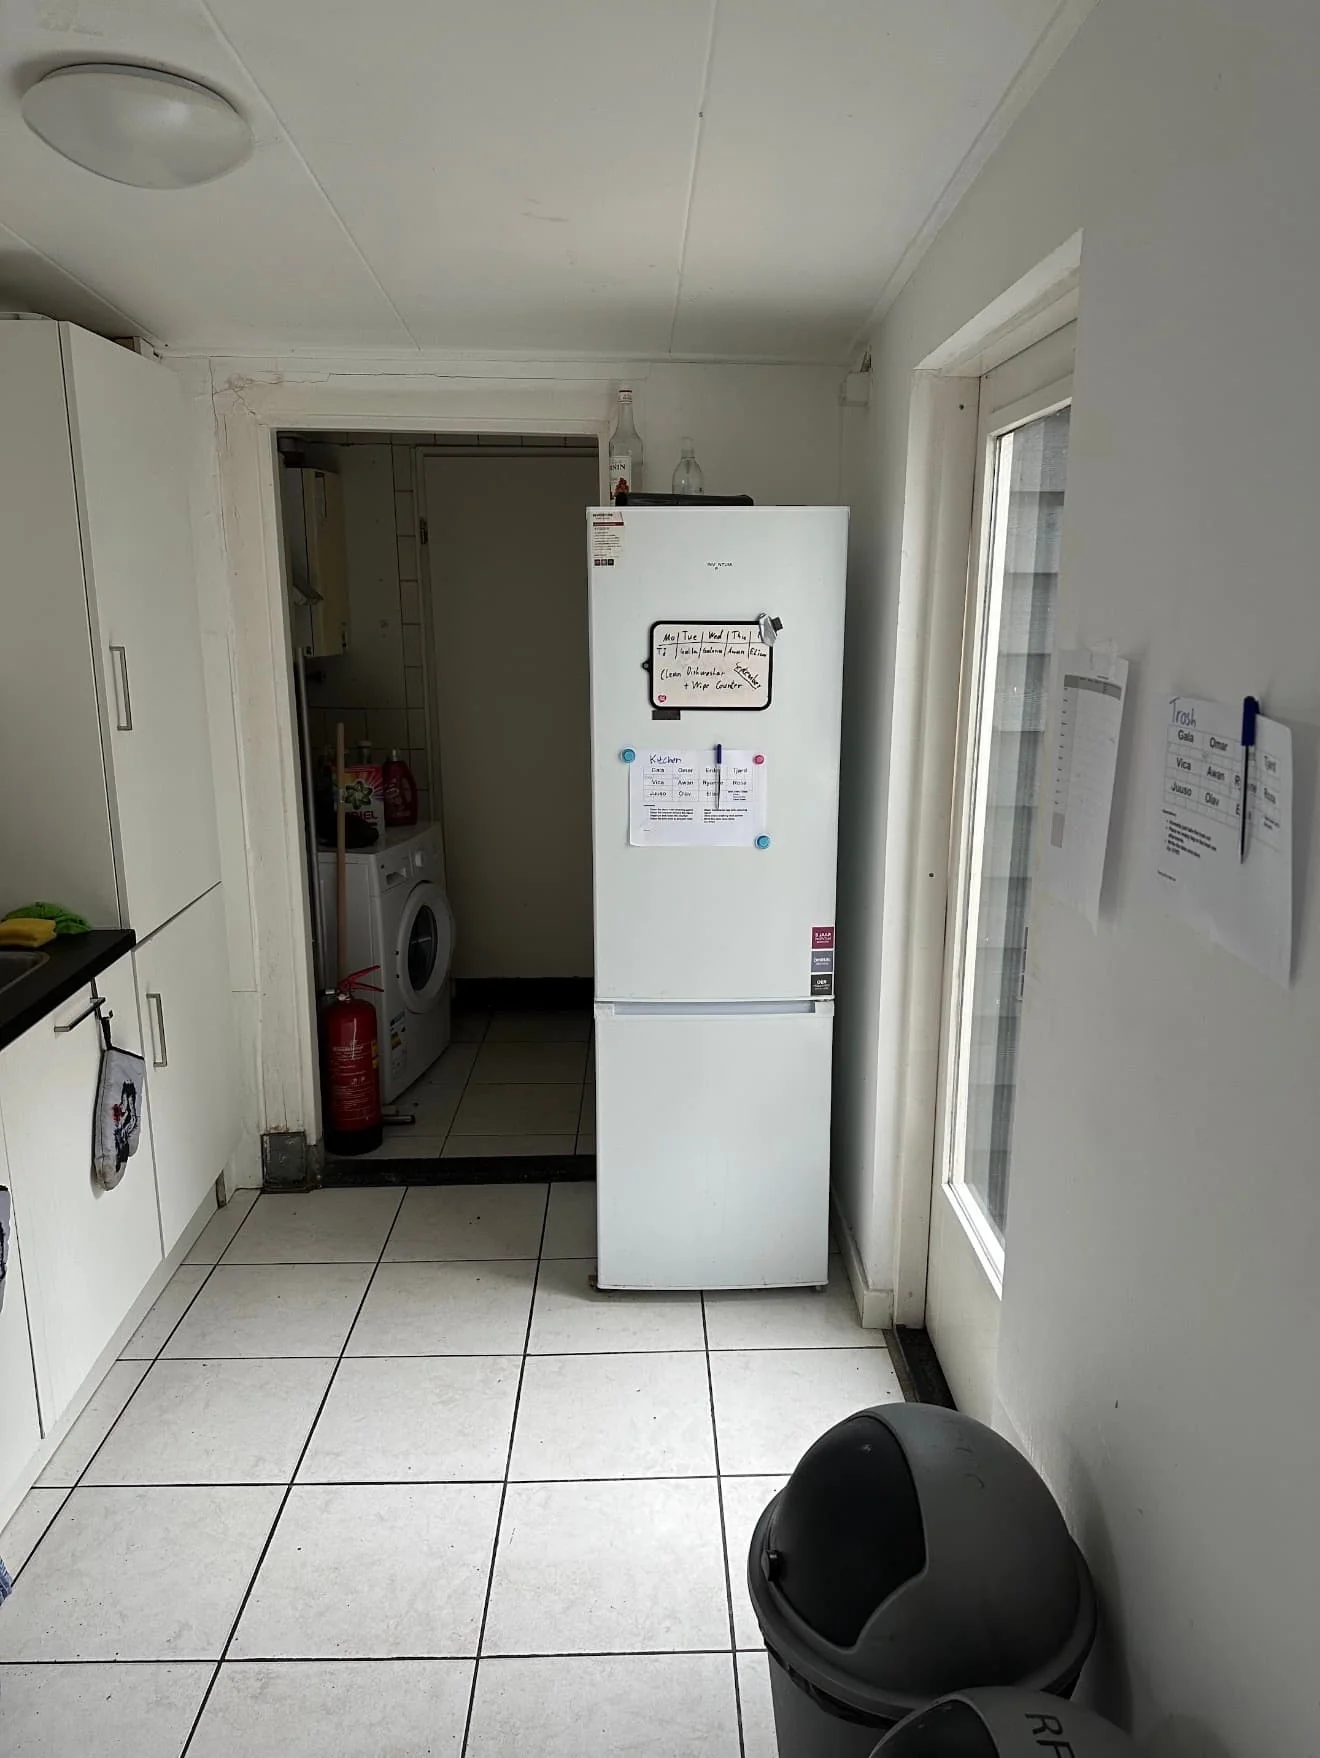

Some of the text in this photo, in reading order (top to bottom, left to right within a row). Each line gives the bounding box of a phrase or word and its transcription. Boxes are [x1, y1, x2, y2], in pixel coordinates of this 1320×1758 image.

[682, 630, 697, 641] Tue
[708, 628, 724, 640] Wed
[1169, 696, 1197, 728] Trash
[649, 752, 682, 765] Kitchen
[1176, 757, 1192, 771] Vica
